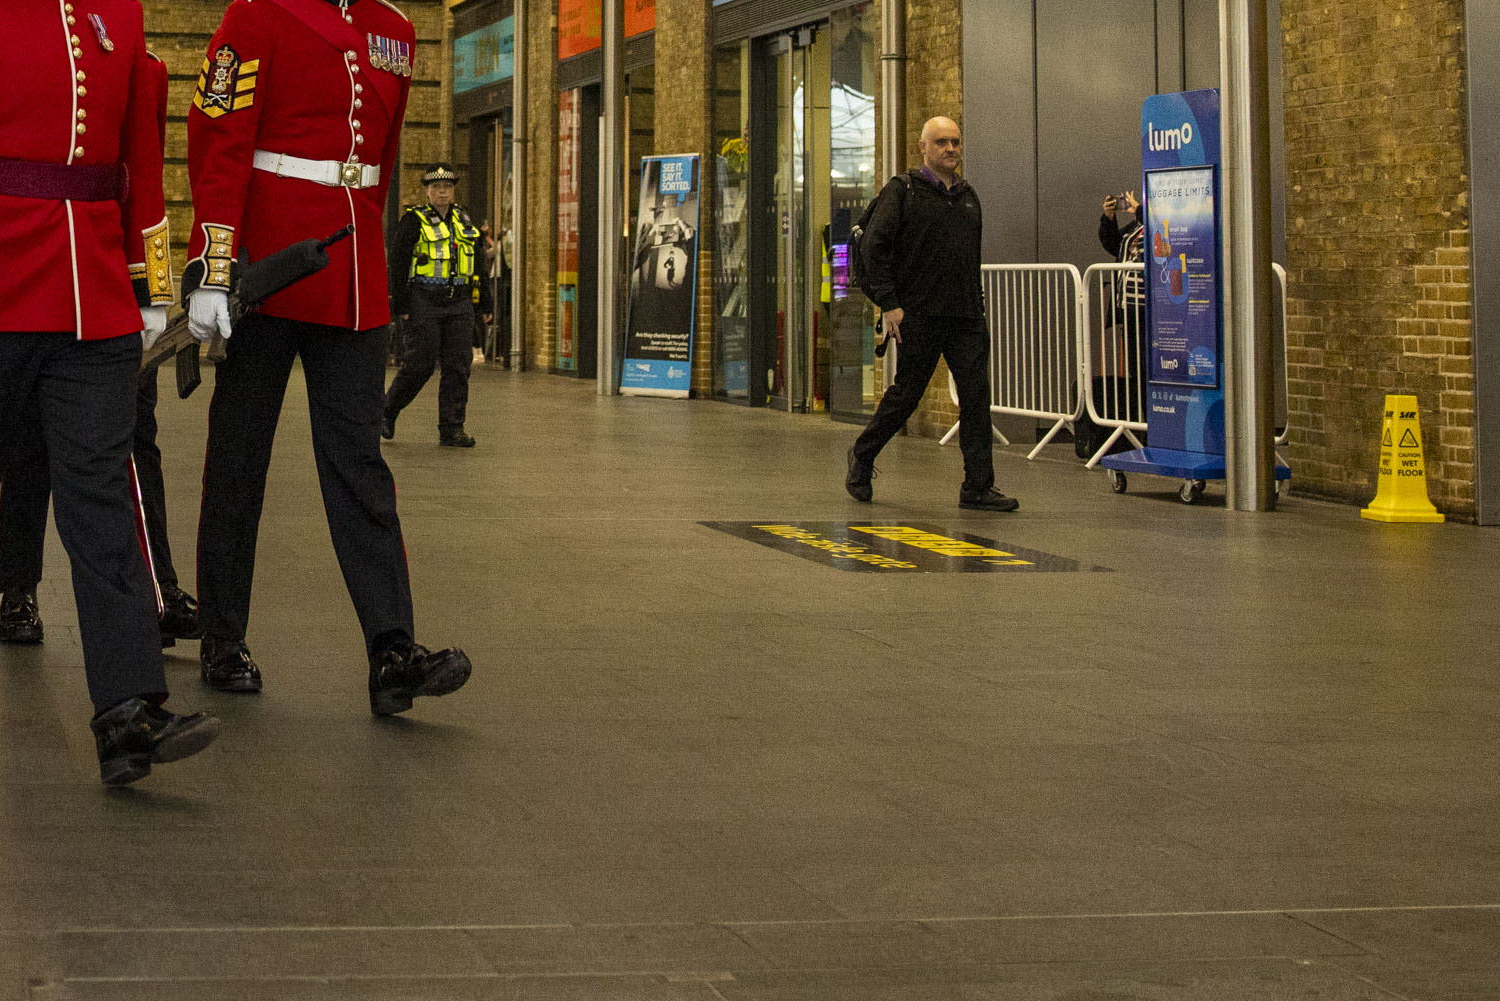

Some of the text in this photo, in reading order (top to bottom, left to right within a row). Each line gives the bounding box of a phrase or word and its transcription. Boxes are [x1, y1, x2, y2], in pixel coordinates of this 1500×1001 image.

[1148, 122, 1192, 151] lumo
[1185, 186, 1210, 197] LIMITS
[1160, 355, 1179, 370] lumo
[1397, 469, 1423, 477] FLOOR
